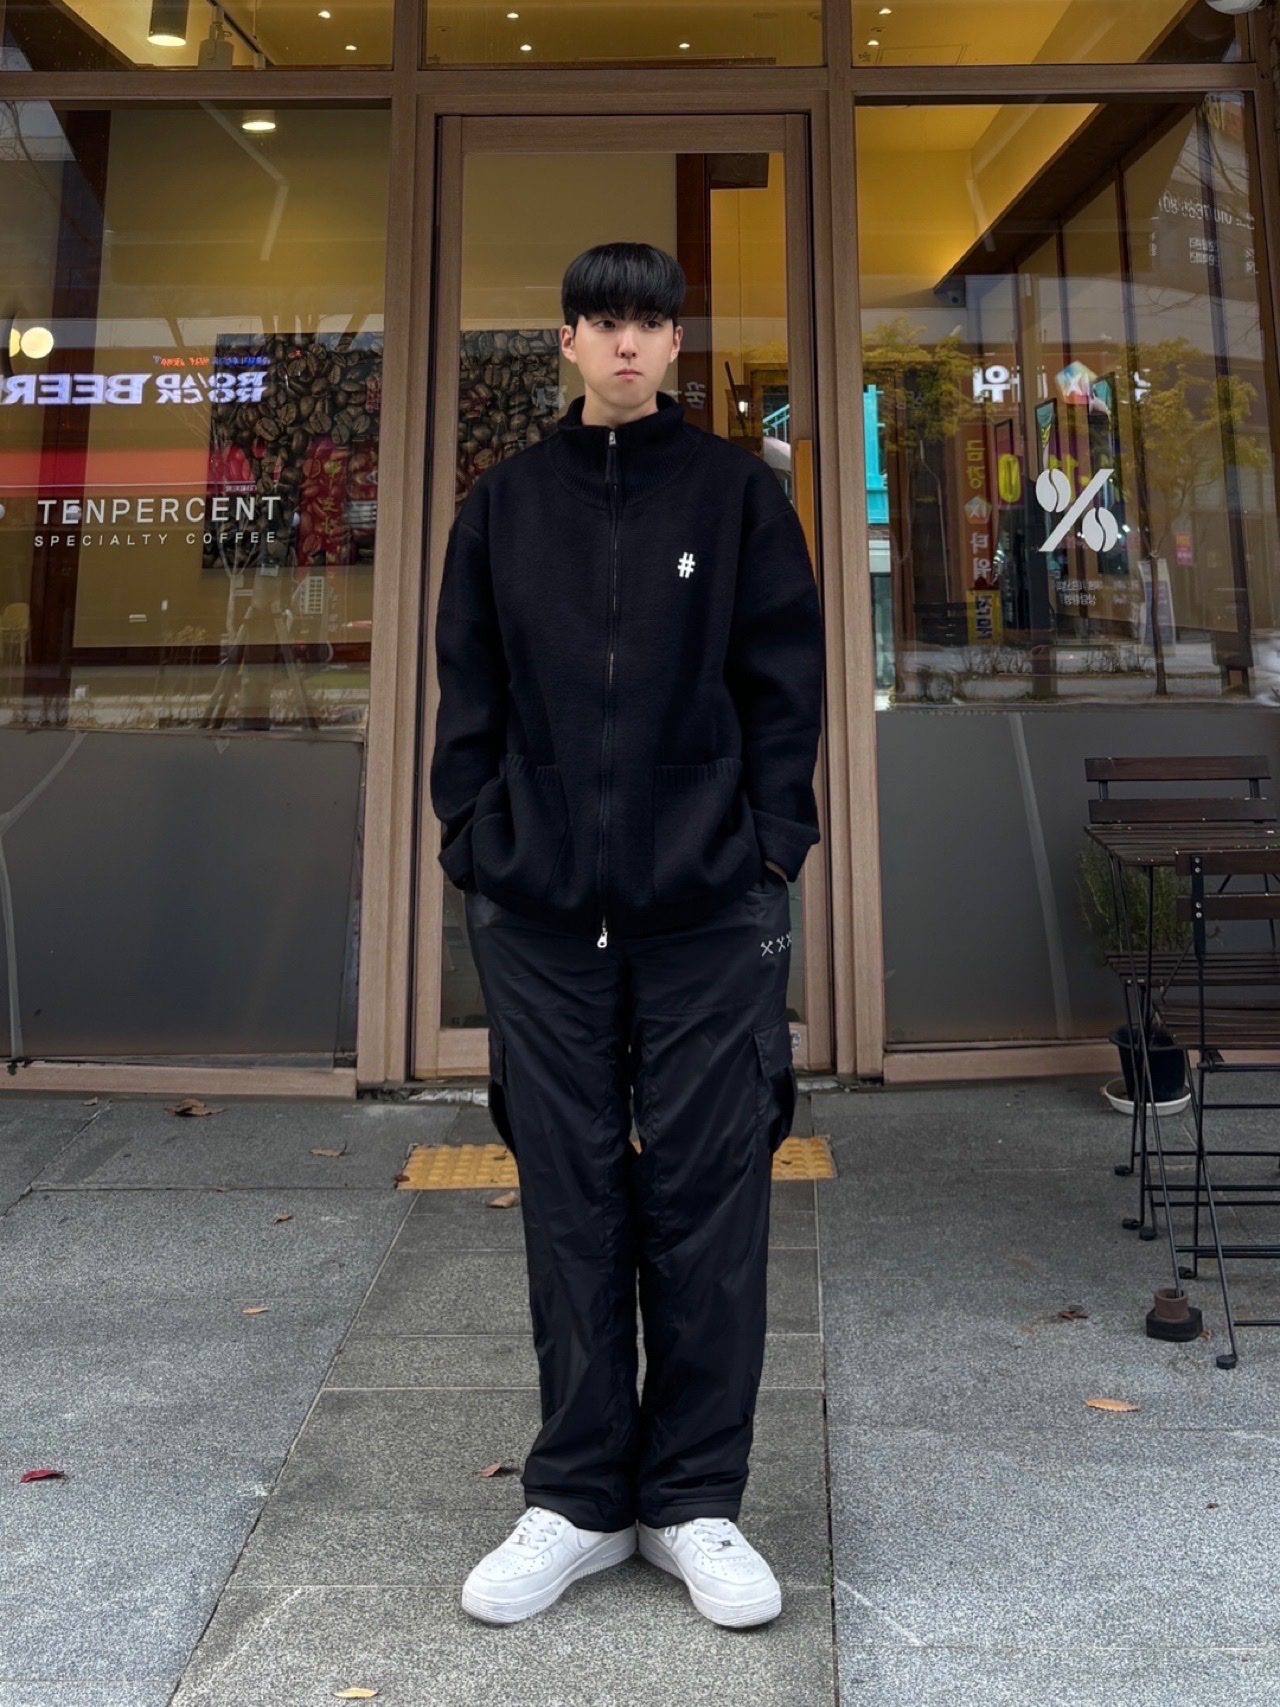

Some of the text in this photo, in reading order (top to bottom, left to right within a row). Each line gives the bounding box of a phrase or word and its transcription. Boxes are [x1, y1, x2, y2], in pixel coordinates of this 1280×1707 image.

[37, 496, 281, 525] TENPERCENT
[34, 531, 275, 547] SPECIALTY COFFEE
